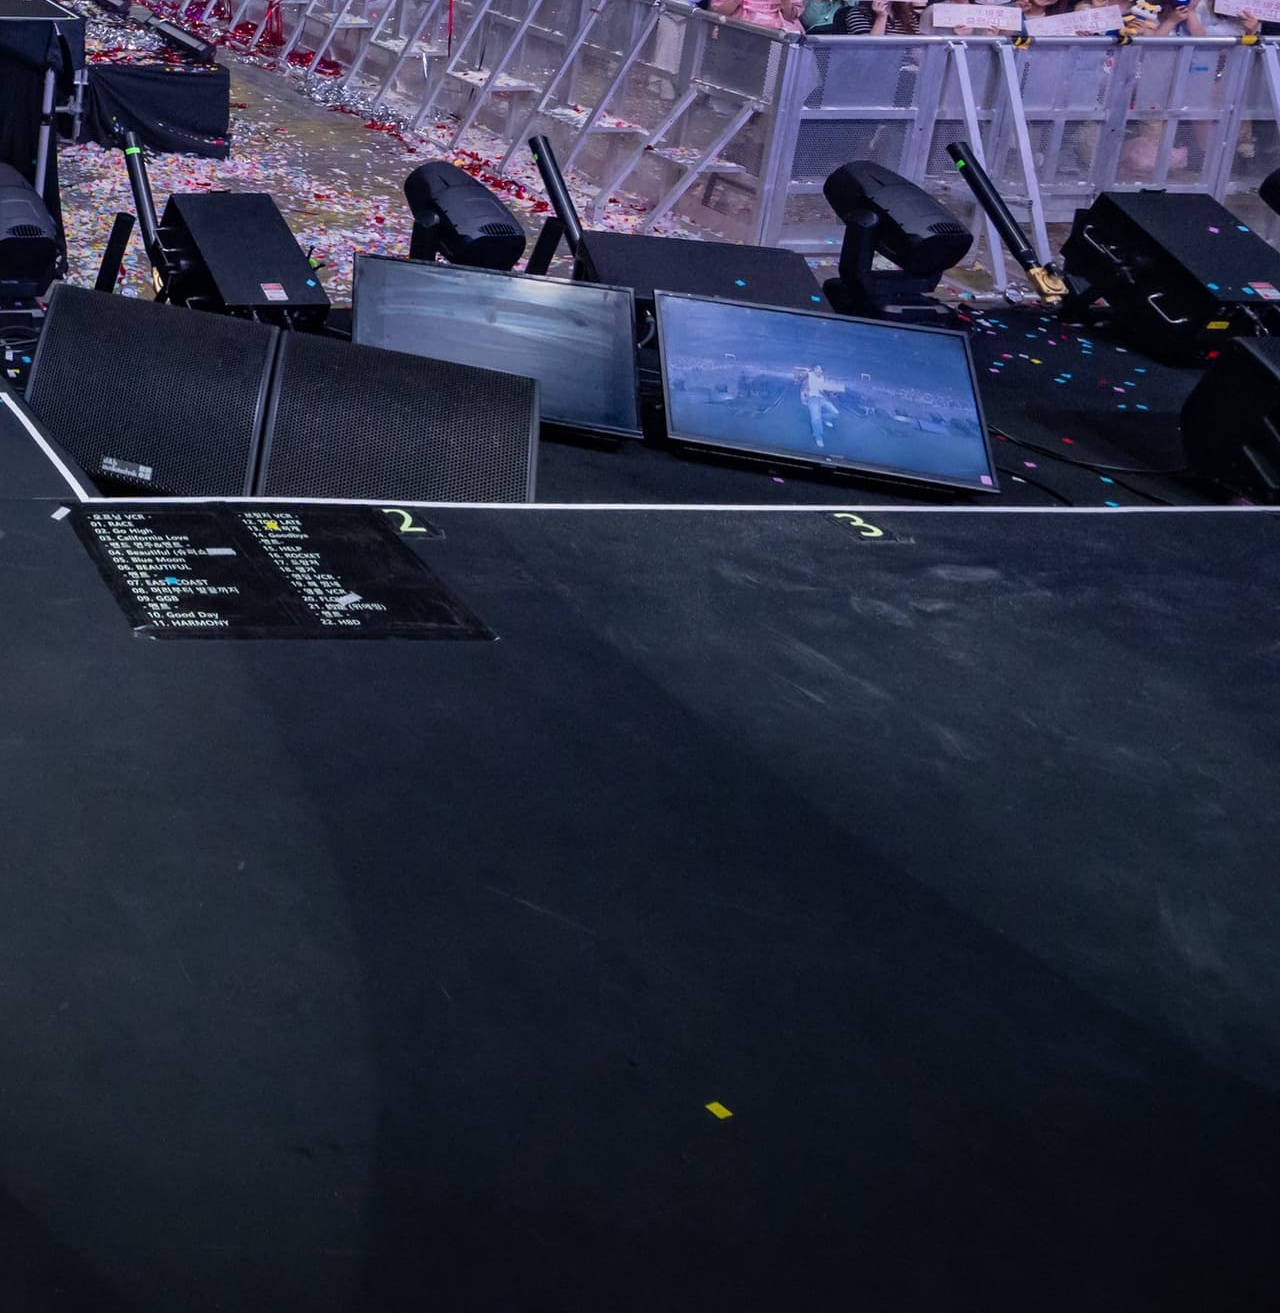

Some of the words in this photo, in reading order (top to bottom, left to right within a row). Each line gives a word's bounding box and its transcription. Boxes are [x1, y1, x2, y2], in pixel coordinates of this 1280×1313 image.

[381, 508, 427, 533] 2
[833, 512, 884, 538] 3
[197, 611, 218, 619] Day
